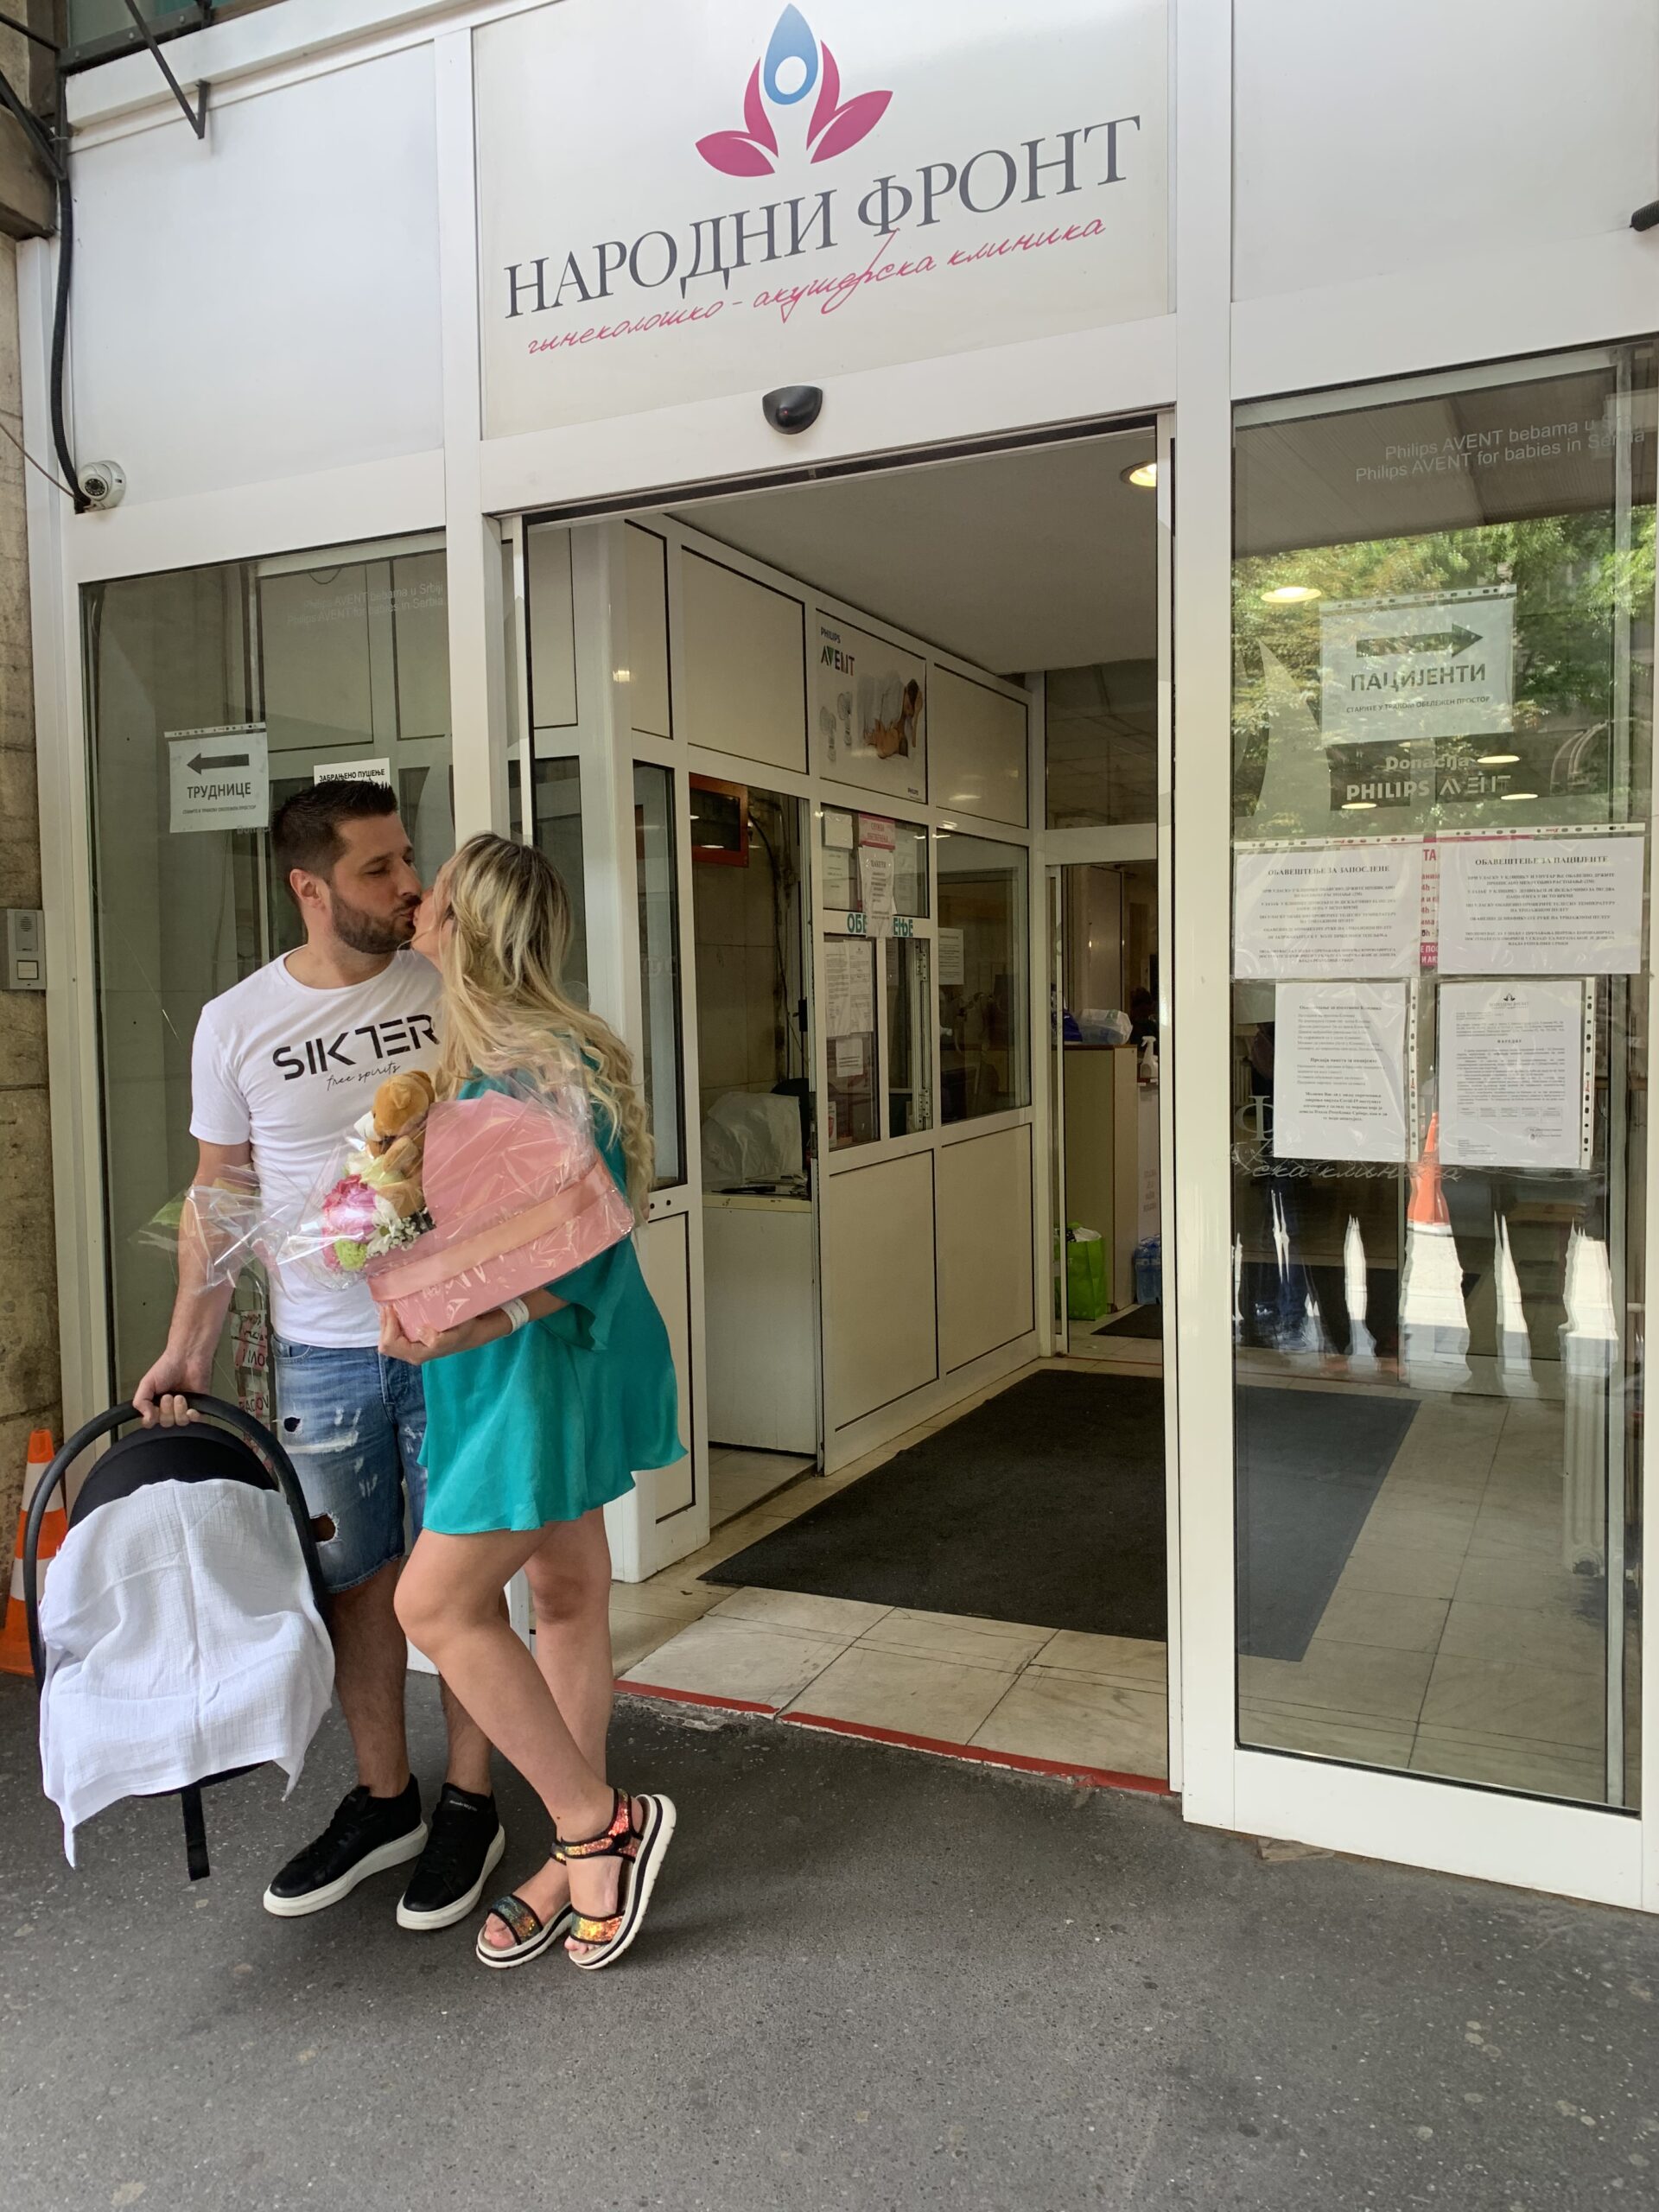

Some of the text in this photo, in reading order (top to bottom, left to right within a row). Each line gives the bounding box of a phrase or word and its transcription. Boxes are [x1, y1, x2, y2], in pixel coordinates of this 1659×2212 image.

[505, 115, 1141, 318] НАРОДНИ ФРОНТ
[946, 218, 1106, 268] клиника
[1385, 442, 1438, 461] Philips
[1441, 429, 1503, 453] AVENT
[1509, 420, 1578, 442] bebama
[1356, 462, 1408, 482] Philips
[1412, 452, 1471, 474] AVENT
[1477, 449, 1498, 467] for
[1504, 440, 1561, 462] babies
[1567, 436, 1582, 452] in
[821, 626, 841, 644] PHILIPS
[821, 645, 855, 676] AVENT
[1351, 664, 1485, 692] ПАЦИЈЕНТИ
[319, 768, 385, 782] ЗАБРАЊЕНО ПУШЕЊЕ
[1386, 753, 1469, 770] Donacija
[187, 782, 251, 800] ТРУДНИЦЕ
[1346, 780, 1430, 801] PHILIPS
[272, 1014, 441, 1081] SIKTER
